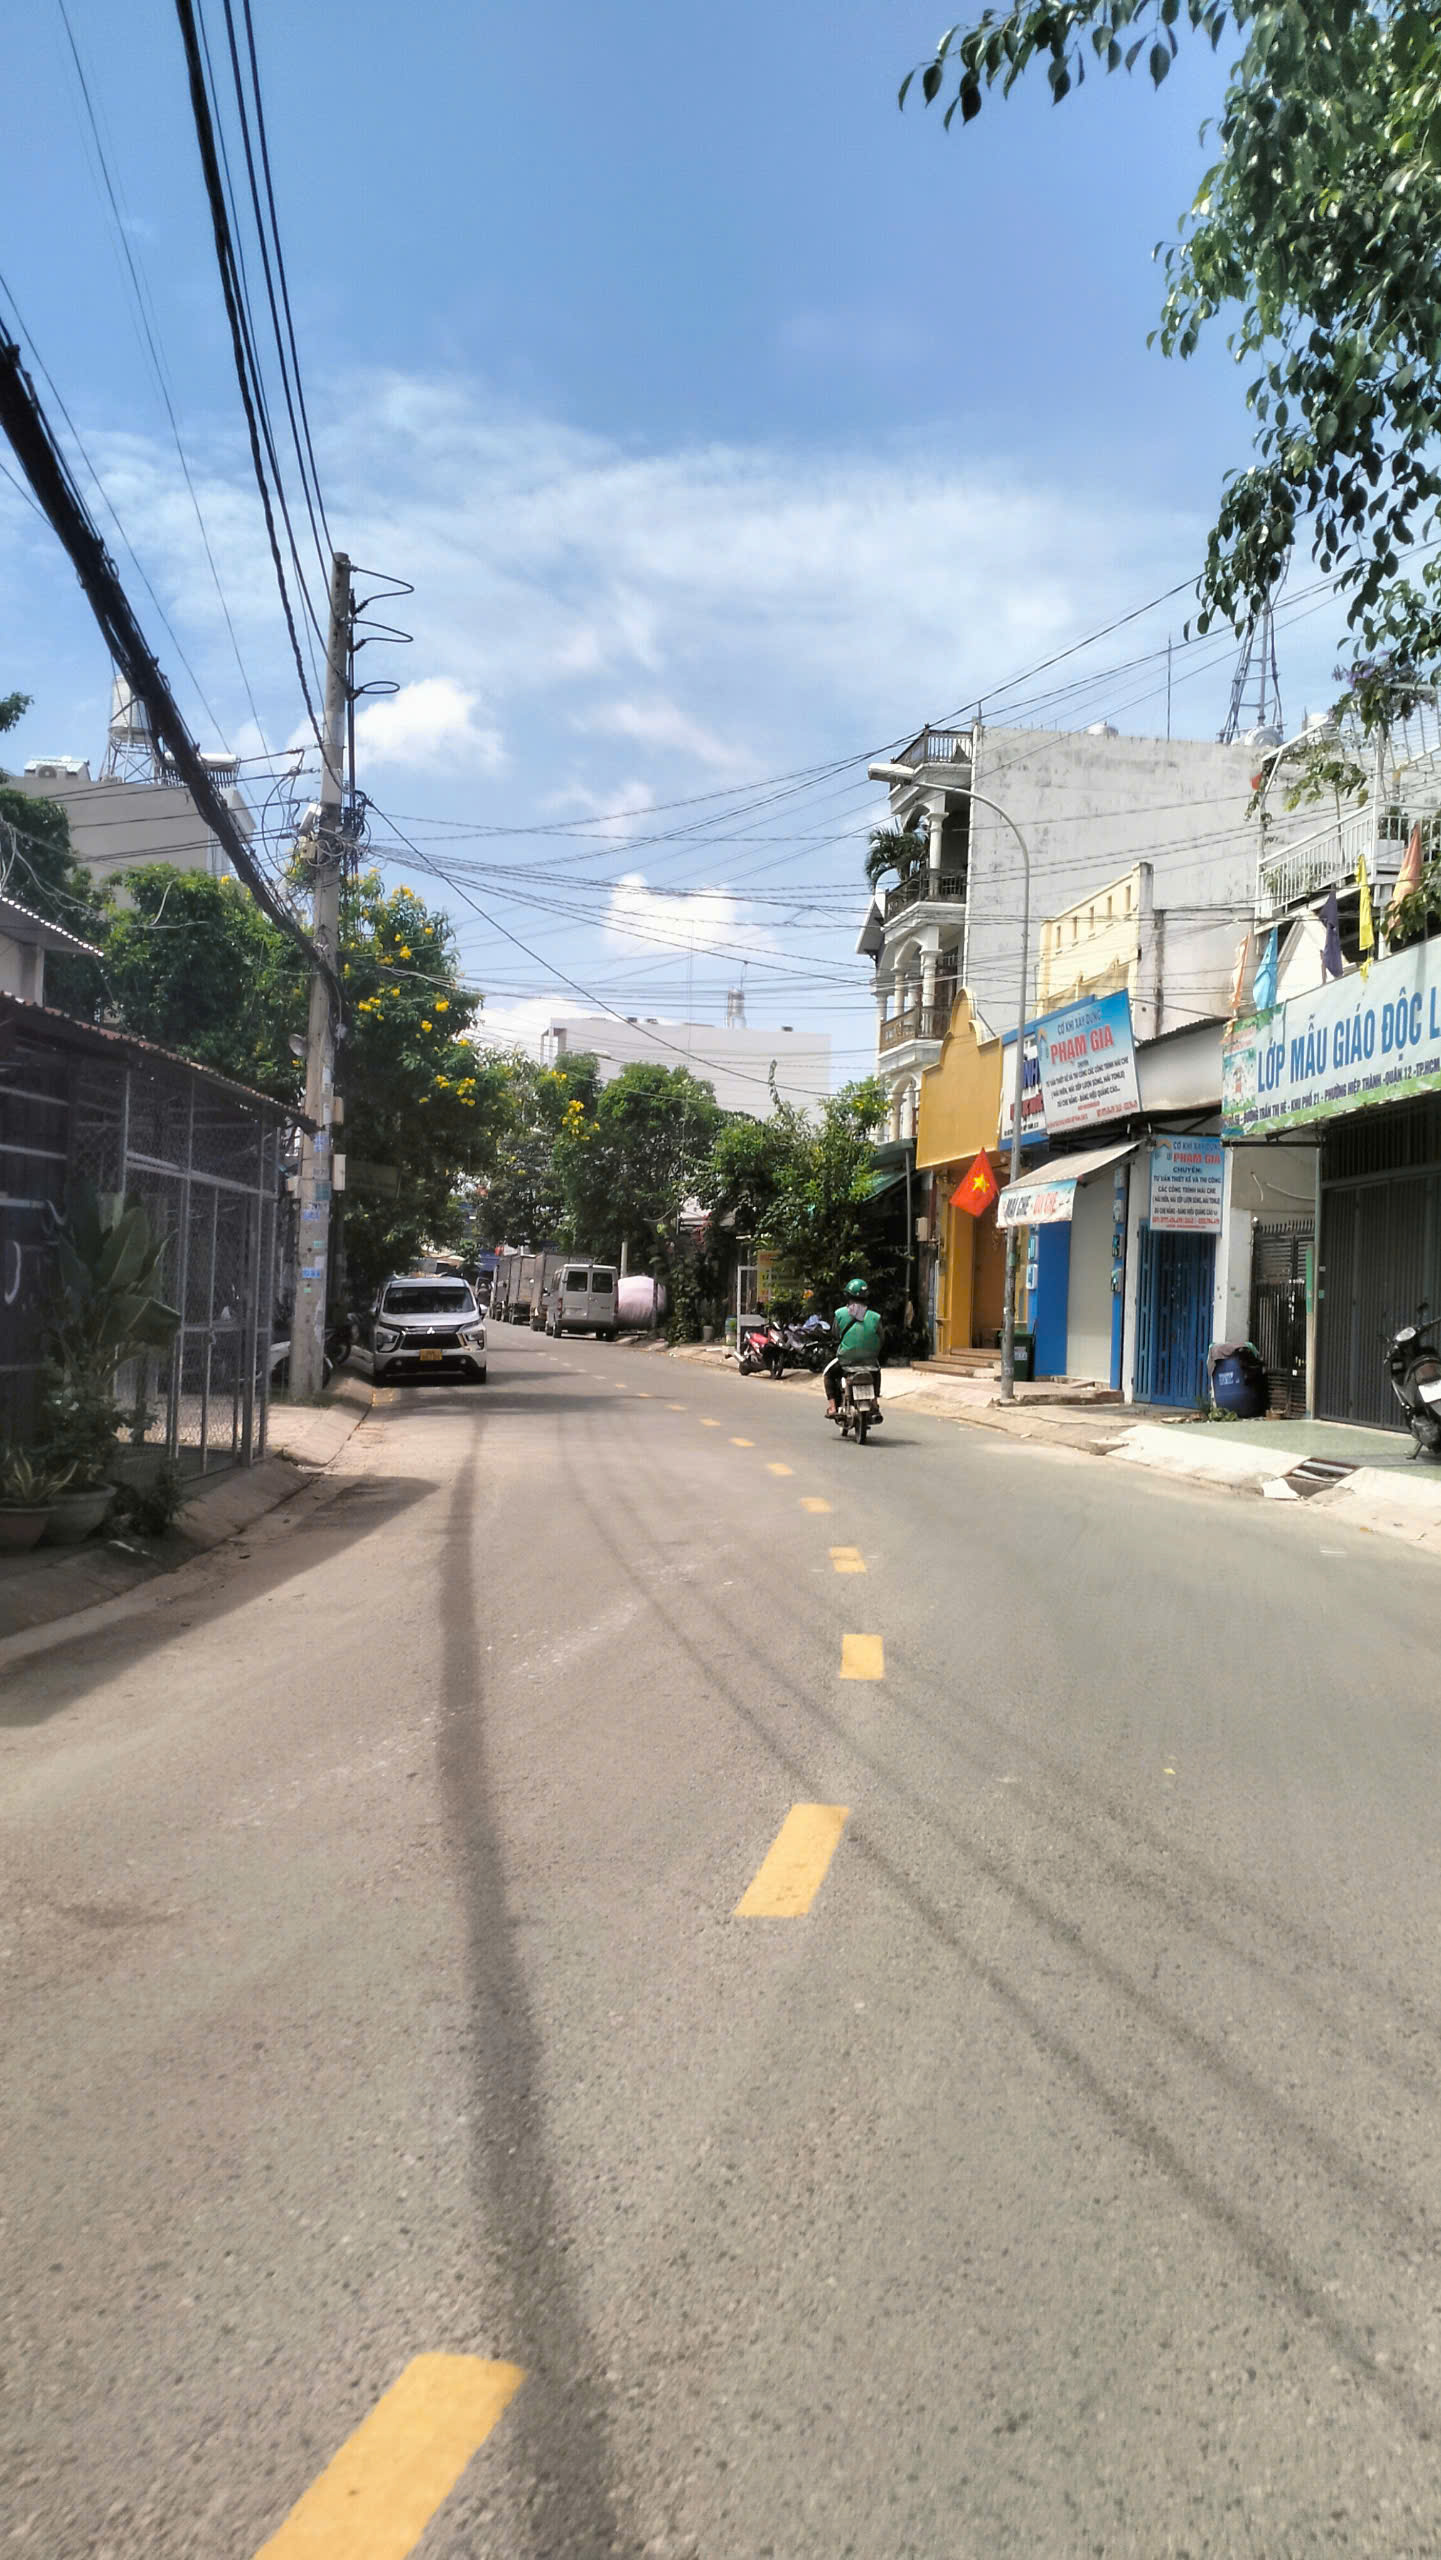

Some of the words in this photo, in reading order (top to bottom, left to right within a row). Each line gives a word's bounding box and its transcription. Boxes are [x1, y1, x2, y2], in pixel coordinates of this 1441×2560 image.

[1050, 1034, 1087, 1065] PHẠM
[1090, 1024, 1113, 1051] GIA
[1258, 1038, 1286, 1093] LỚP
[1290, 1014, 1327, 1084] MẪU
[1333, 1003, 1375, 1069] GIÁO
[1382, 986, 1422, 1061] ĐỘC
[1348, 1079, 1360, 1096] HIỆP
[1362, 1073, 1381, 1091] THÀNH
[1404, 1065, 1412, 1080] 12
[1173, 1152, 1202, 1165] PHẠM
[1205, 1154, 1221, 1165] GIA
